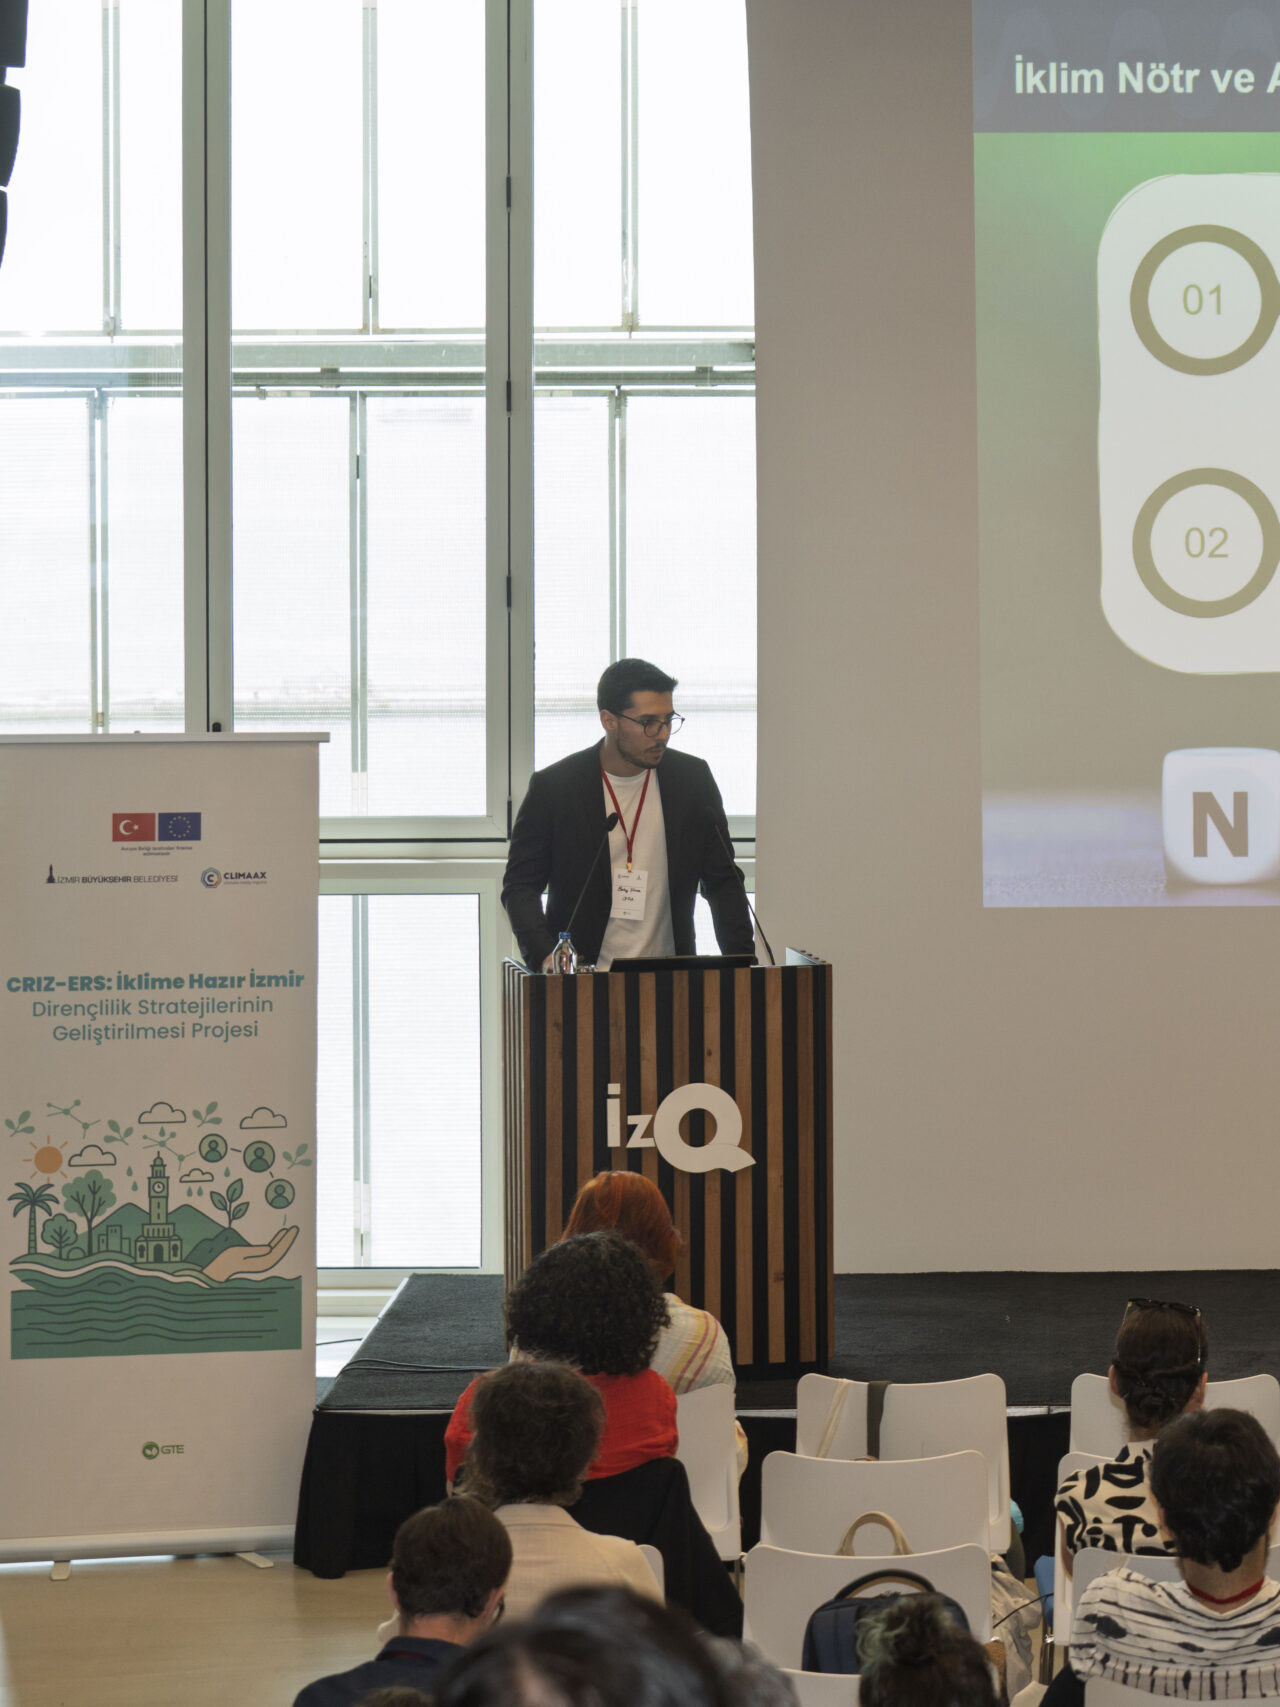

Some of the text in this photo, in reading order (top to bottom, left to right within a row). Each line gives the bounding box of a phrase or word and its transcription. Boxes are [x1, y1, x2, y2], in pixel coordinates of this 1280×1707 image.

[1015, 54, 1104, 94] İklim
[1118, 60, 1201, 94] Nötr
[1211, 68, 1255, 94] ve
[1181, 283, 1223, 316] 01
[1184, 527, 1229, 559] 02
[223, 871, 267, 880] CLIMAAX
[6, 968, 305, 993] CRIZ-ERS: İklime Hazır İzmir
[32, 996, 273, 1021] Dirençlilik Stratejilerinin
[53, 1020, 259, 1045] Geliştirilmesi Projesi
[160, 1444, 185, 1455] GTE
